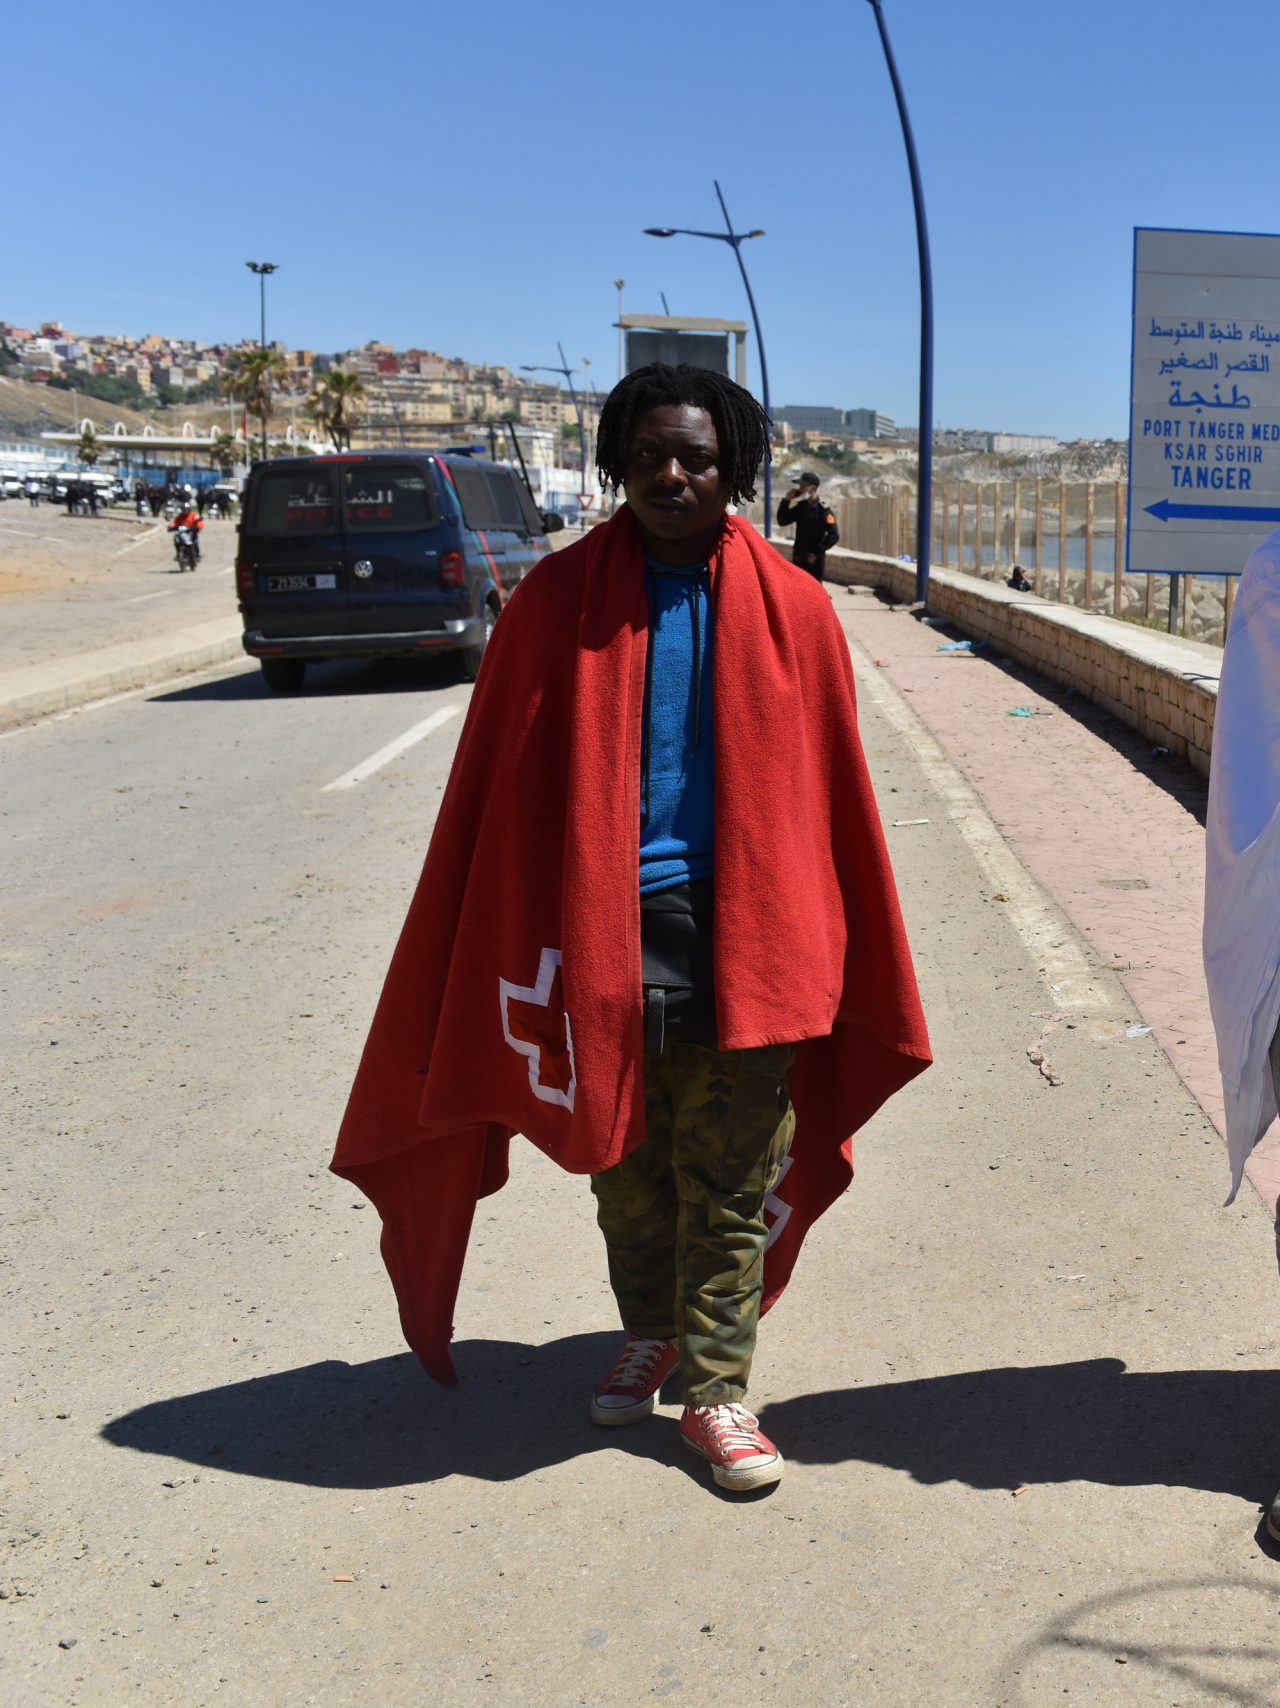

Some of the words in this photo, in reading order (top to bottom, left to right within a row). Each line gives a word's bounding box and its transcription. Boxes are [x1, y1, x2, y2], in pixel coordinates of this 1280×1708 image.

[1149, 318, 1205, 346] المتوسط
[1208, 321, 1243, 344] طنجة
[1249, 323, 1280, 348] ميناء
[1158, 351, 1219, 375] الصغير
[1224, 353, 1270, 378] القصر
[1168, 380, 1251, 414] طنجة
[1143, 418, 1182, 437] PORT
[1188, 421, 1245, 440] TANGER
[1251, 423, 1280, 442] MED
[1164, 442, 1207, 461] KSAR
[1215, 444, 1263, 463] SGHIR
[1170, 465, 1252, 490] TANGER
[287, 489, 393, 508] الشطة
[287, 506, 393, 522] POICE
